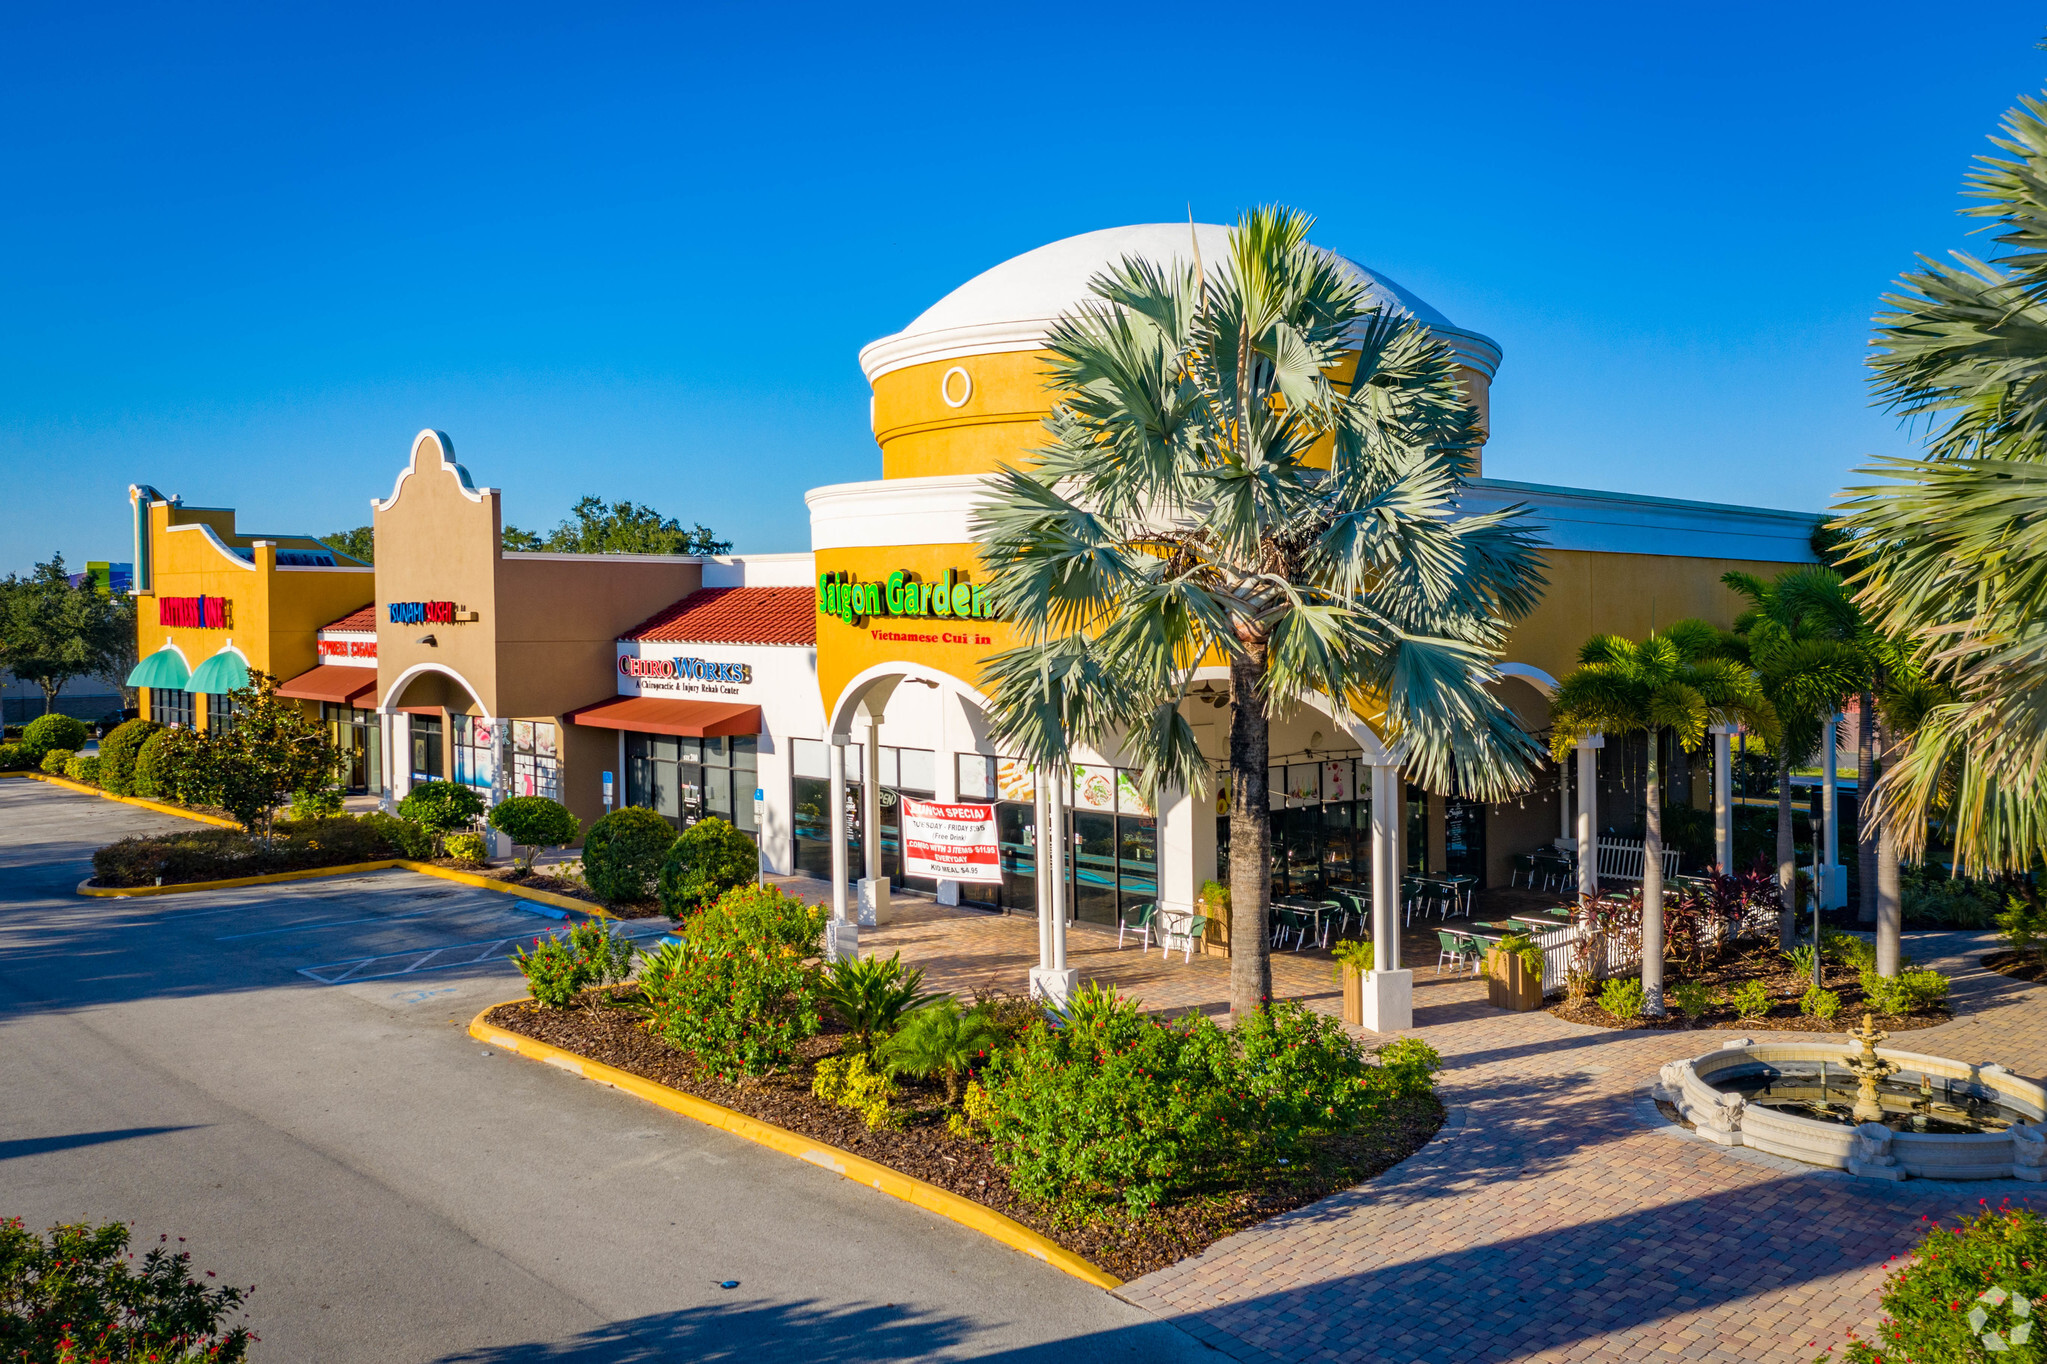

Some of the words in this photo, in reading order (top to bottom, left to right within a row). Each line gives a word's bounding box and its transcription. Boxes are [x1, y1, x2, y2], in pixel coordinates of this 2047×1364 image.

[819, 572, 880, 624] Saigon
[886, 568, 993, 617] Garden
[159, 597, 199, 626] MATTRESS
[204, 597, 226, 628] ONE
[387, 602, 424, 623] TSUNAMI
[426, 601, 452, 622] SUSHI
[871, 630, 938, 643] Vietnamese
[317, 640, 348, 656] CYPRESS
[351, 642, 377, 658] CIGARS
[641, 681, 674, 691] Chiropractic
[682, 683, 699, 693] Injury
[701, 684, 718, 693] Rehab
[720, 685, 739, 695] Center
[880, 792, 893, 805] PEN
[947, 823, 968, 832] FRIDAY
[930, 844, 946, 853] WITH
[952, 846, 973, 854] ITEMS
[975, 846, 995, 854] $11.95
[935, 854, 967, 863] EVERYDAY
[942, 865, 960, 874] MEAL
[960, 866, 978, 875] $4.95
